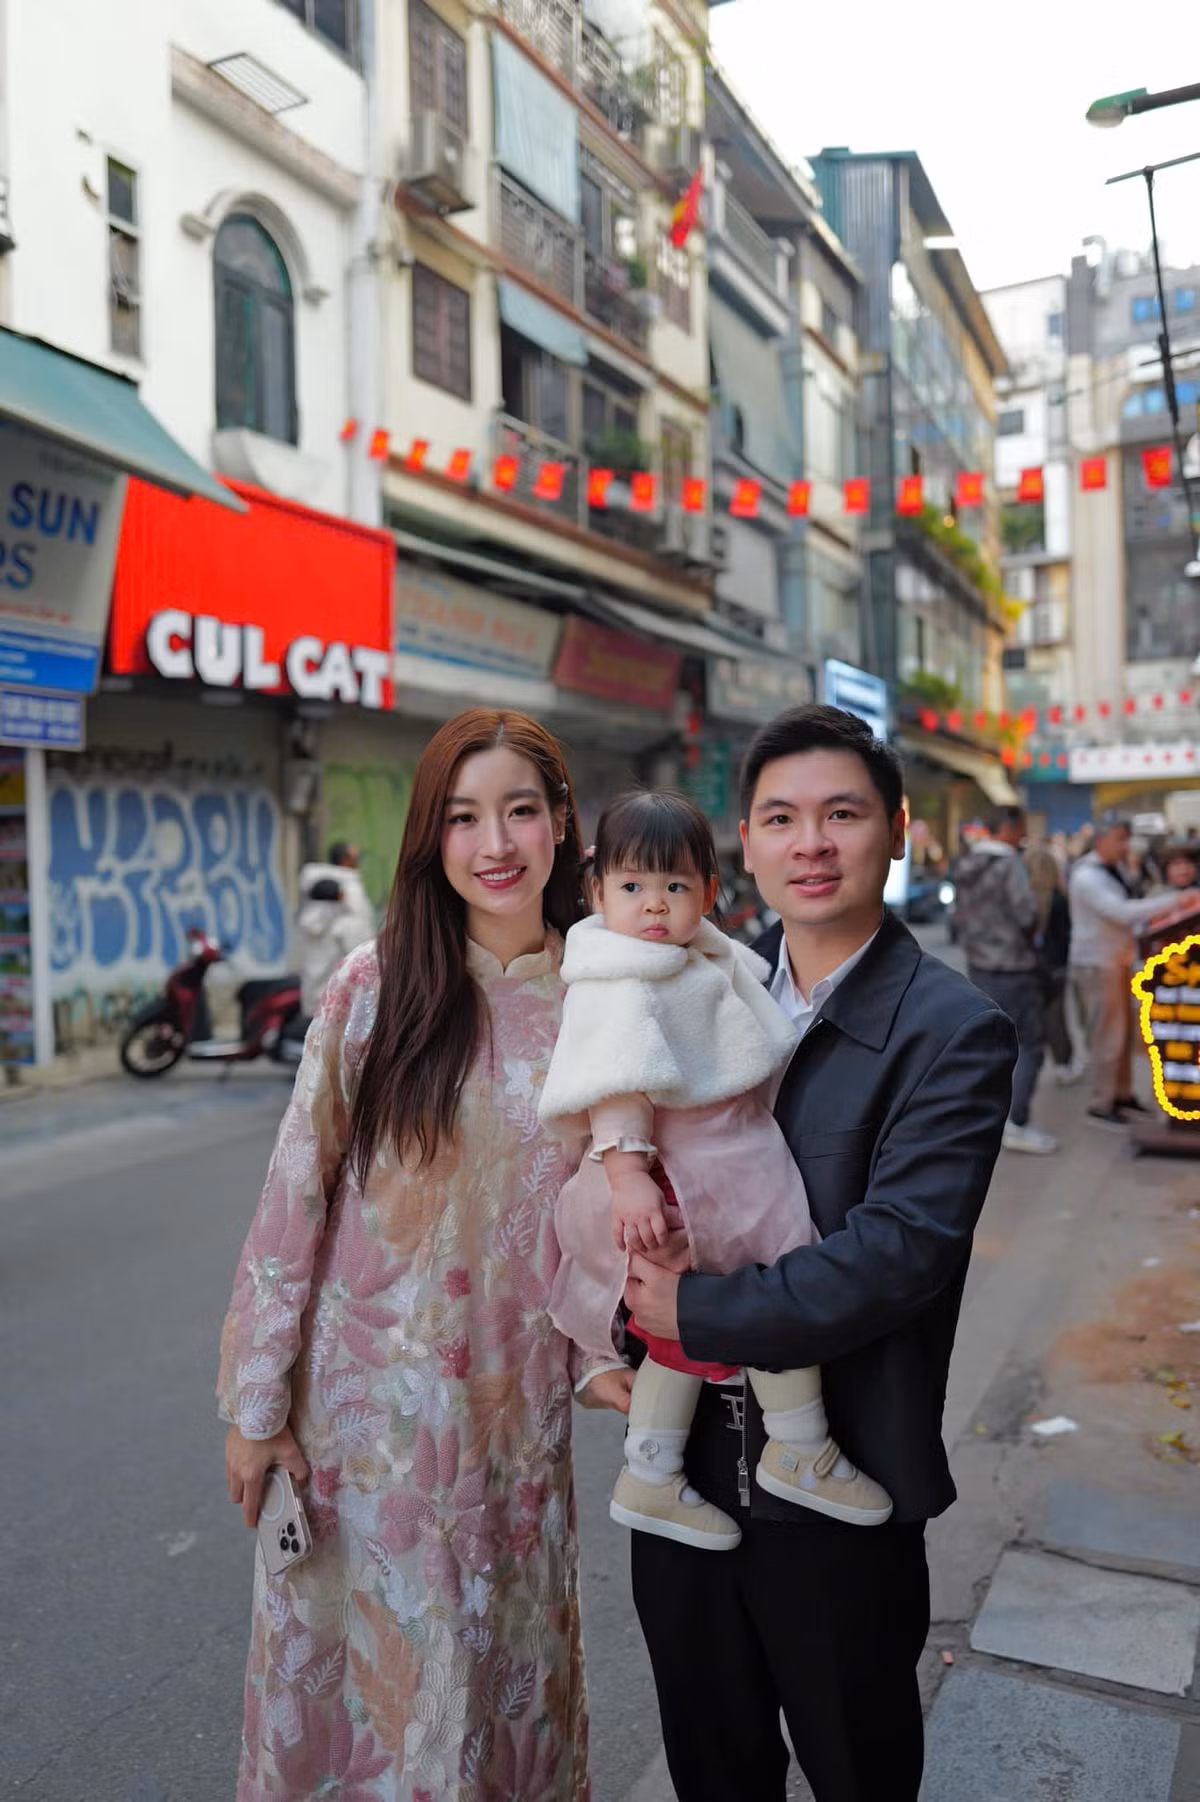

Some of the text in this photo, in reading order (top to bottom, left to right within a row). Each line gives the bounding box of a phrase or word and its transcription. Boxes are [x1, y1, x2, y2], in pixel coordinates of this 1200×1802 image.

[8, 481, 99, 545] SUN
[0, 540, 36, 590] S
[147, 609, 280, 689] CUL
[287, 635, 390, 709] CAT
